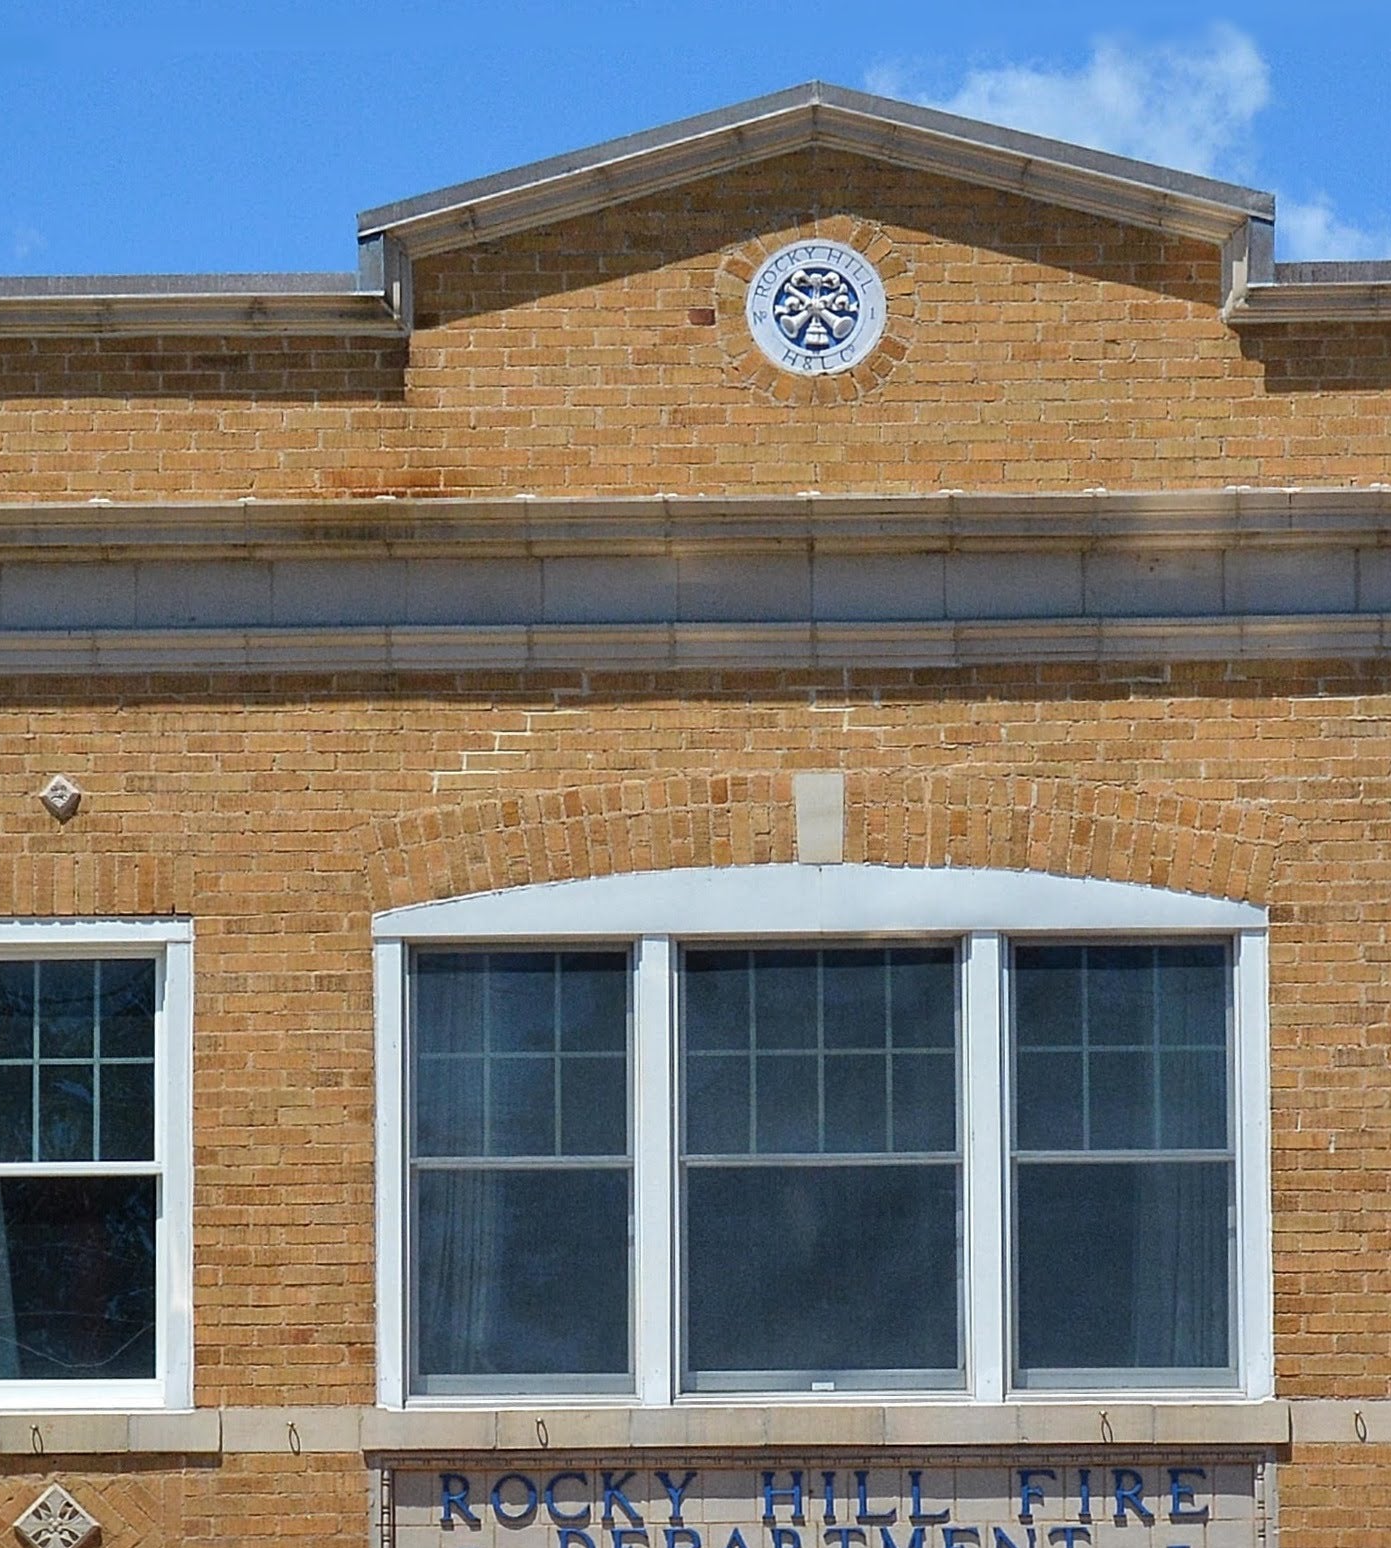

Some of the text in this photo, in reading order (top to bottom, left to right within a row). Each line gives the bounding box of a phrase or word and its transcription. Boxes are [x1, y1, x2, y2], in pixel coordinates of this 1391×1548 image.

[755, 247, 874, 298] ROCKY HILL
[439, 1467, 1209, 1529] ROCKY HILL FIRE
